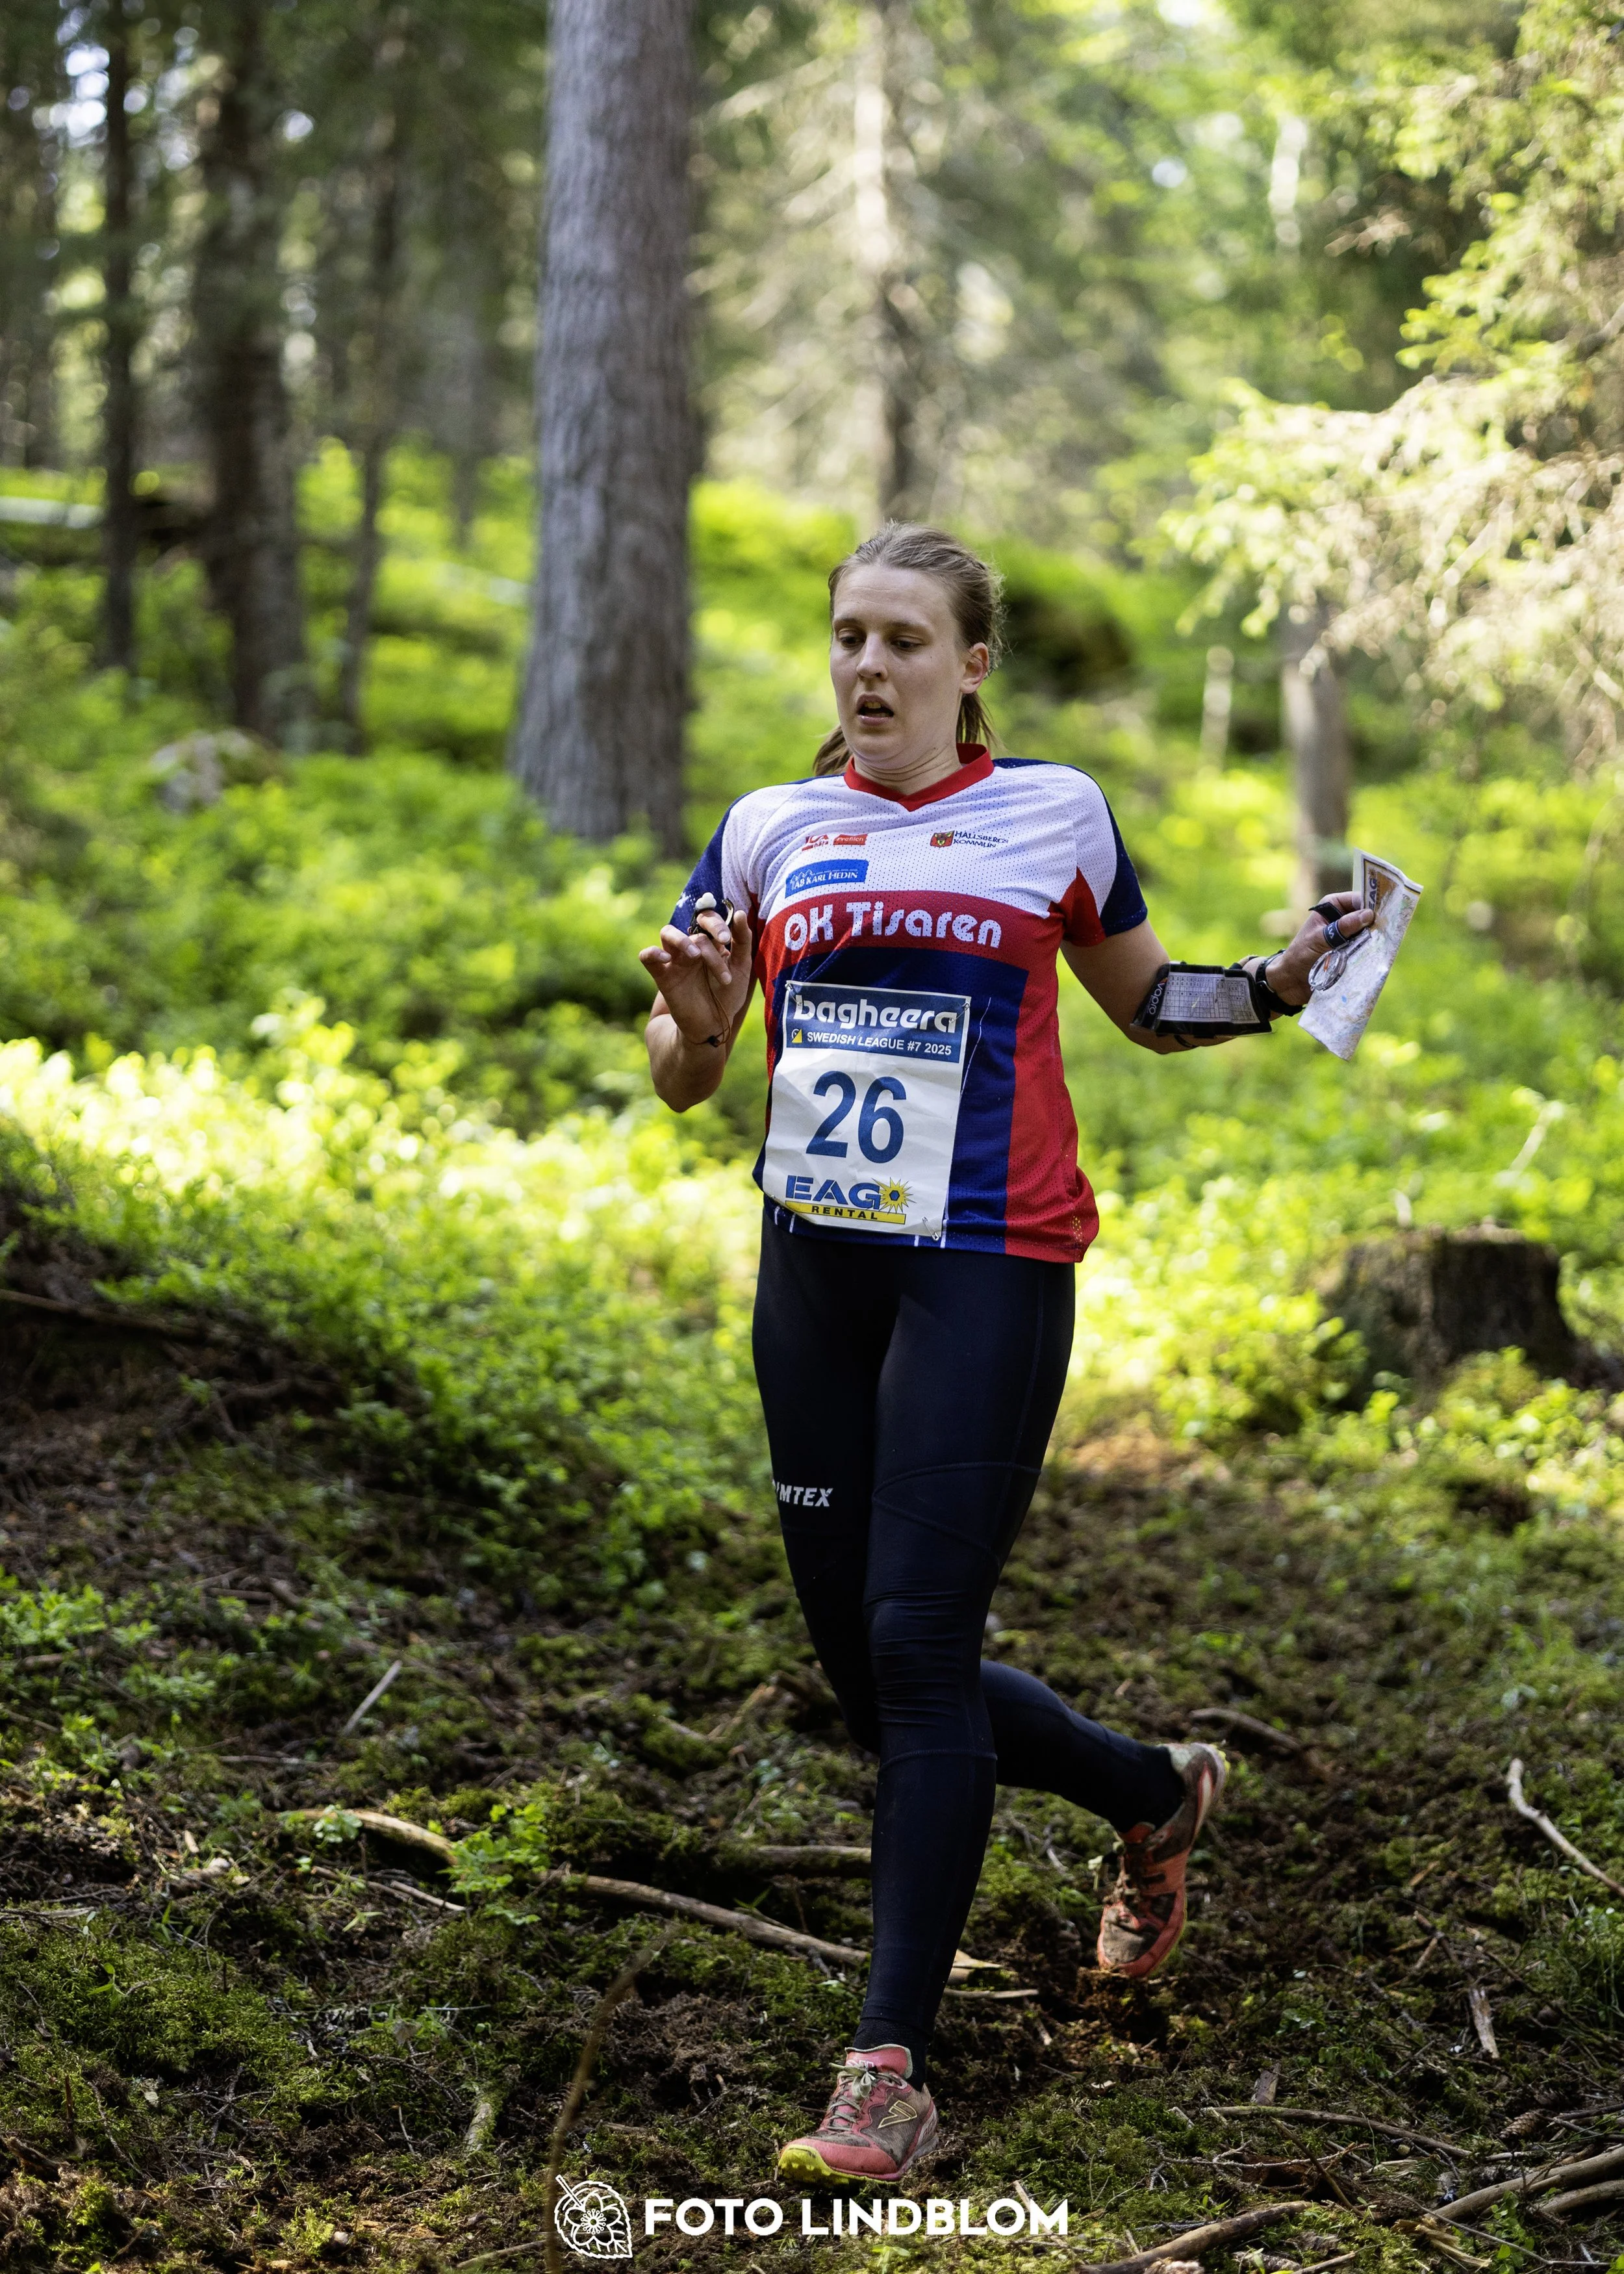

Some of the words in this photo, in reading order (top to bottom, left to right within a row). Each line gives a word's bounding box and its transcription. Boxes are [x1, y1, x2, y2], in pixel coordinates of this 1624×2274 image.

[953, 839, 996, 848] KOMMUN
[806, 874, 826, 885] KARL
[828, 871, 858, 880] HEDIN
[784, 904, 833, 951] OK
[846, 901, 1002, 949] Tisaren
[793, 995, 958, 1033] bagheera
[1148, 982, 1165, 1015] vapro
[807, 1031, 856, 1045] SWEDISH
[857, 1036, 904, 1050] LEAGUE
[907, 1041, 922, 1052] #7
[924, 1043, 952, 1056] 2025
[806, 1070, 907, 1164] 26
[785, 1175, 882, 1210] EAG
[811, 1206, 878, 1220] RENTAL
